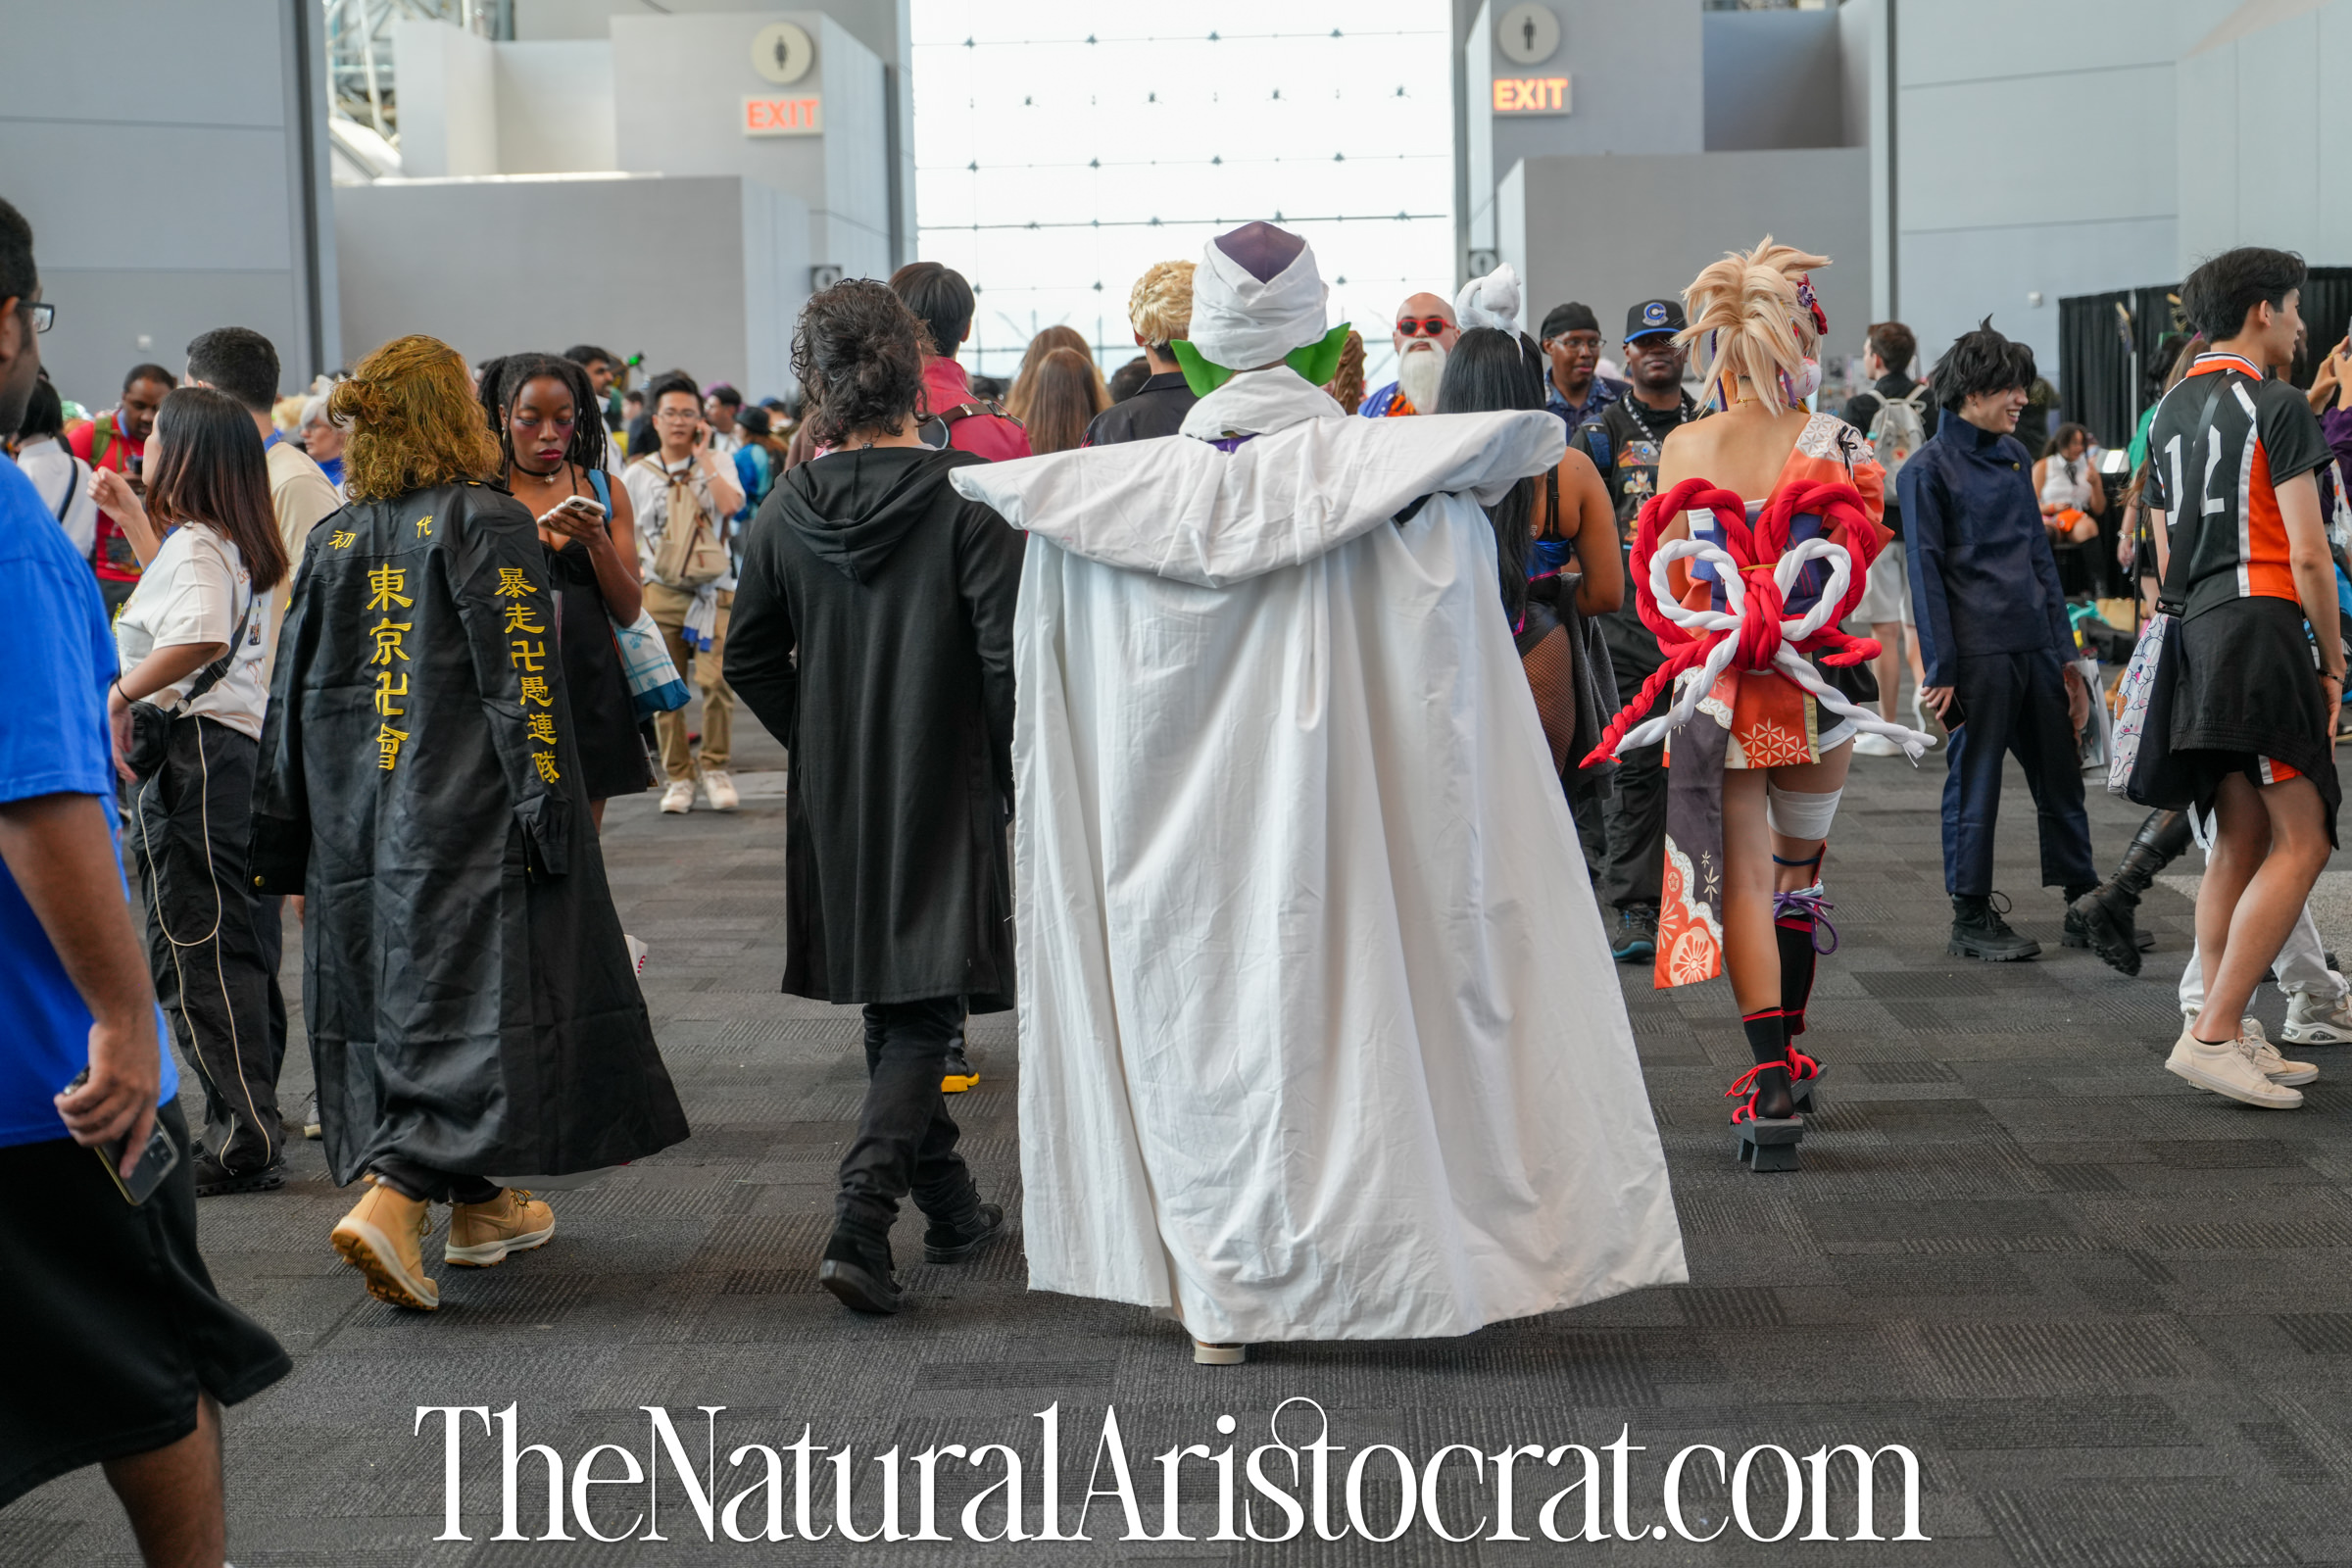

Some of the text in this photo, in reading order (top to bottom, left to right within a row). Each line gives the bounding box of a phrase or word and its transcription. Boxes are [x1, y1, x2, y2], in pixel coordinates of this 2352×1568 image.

[748, 100, 819, 129] EXIT
[1493, 77, 1568, 111] EXIT
[2164, 423, 2226, 526] 12
[366, 563, 414, 770] 東京卍會
